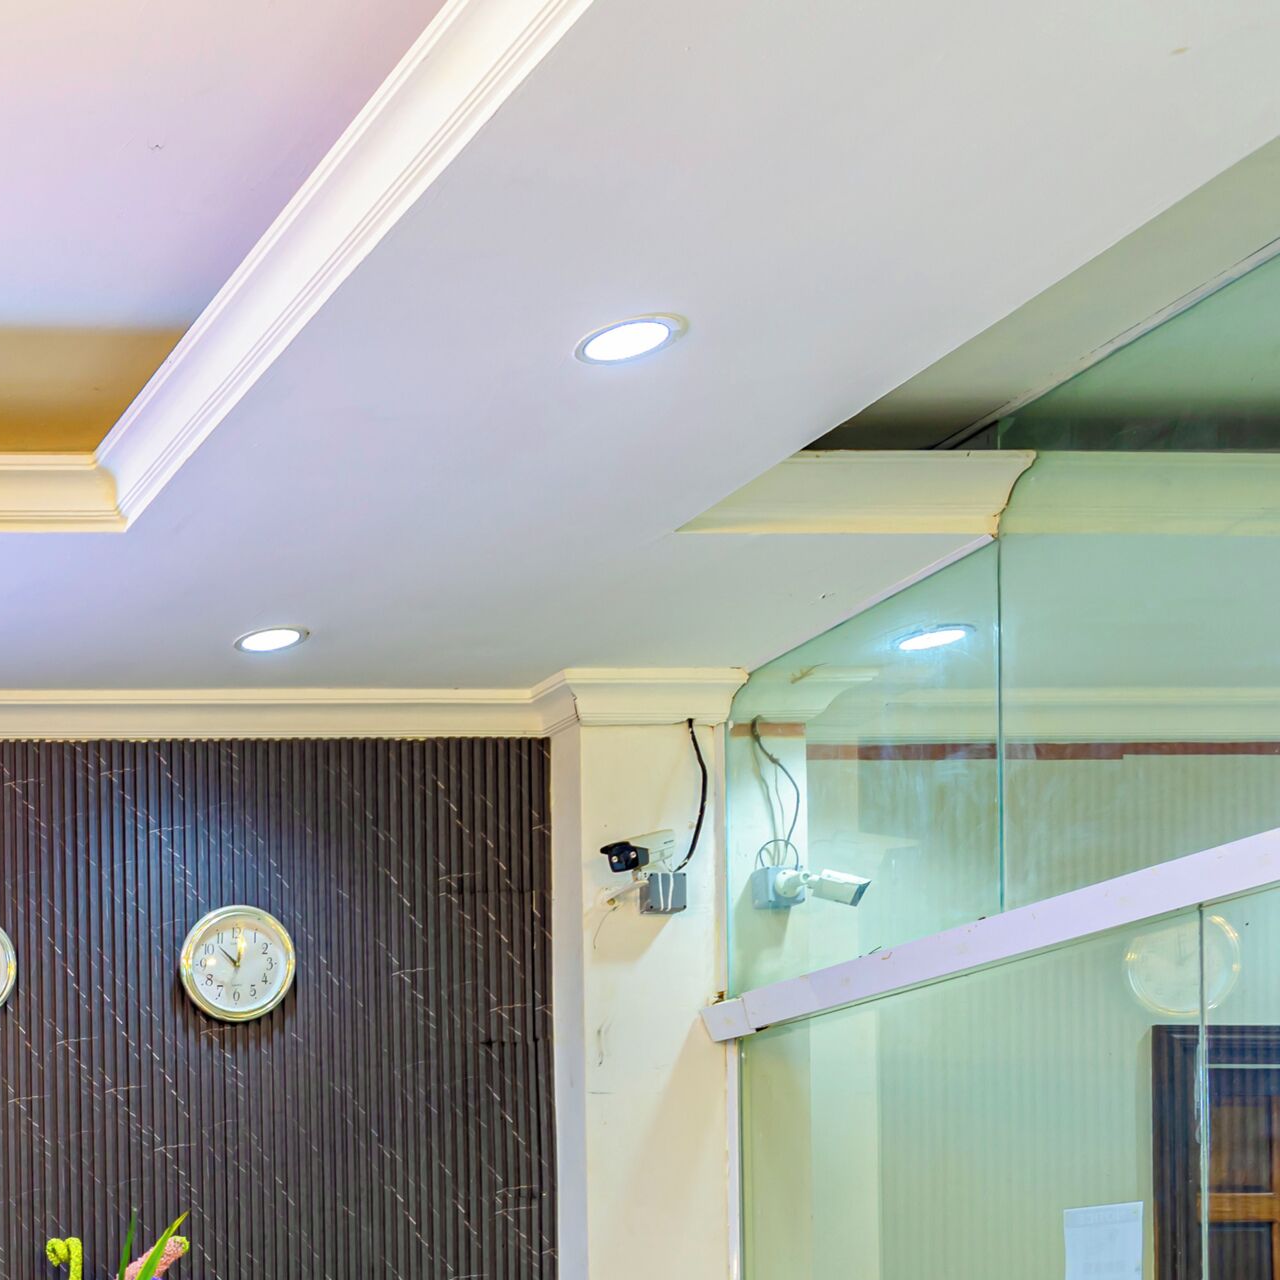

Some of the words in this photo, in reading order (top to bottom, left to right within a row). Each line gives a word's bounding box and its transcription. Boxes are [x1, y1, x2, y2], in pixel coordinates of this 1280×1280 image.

[217, 932, 223, 944] 11
[254, 932, 256, 943] 1
[204, 944, 214, 954] 10
[262, 943, 268, 954] 2
[200, 958, 206, 970] 9
[267, 958, 273, 970] 3
[205, 974, 213, 986] 8
[262, 973, 268, 984] 4
[216, 985, 223, 997] 7
[233, 988, 240, 1001] 6
[250, 985, 256, 996] 5
